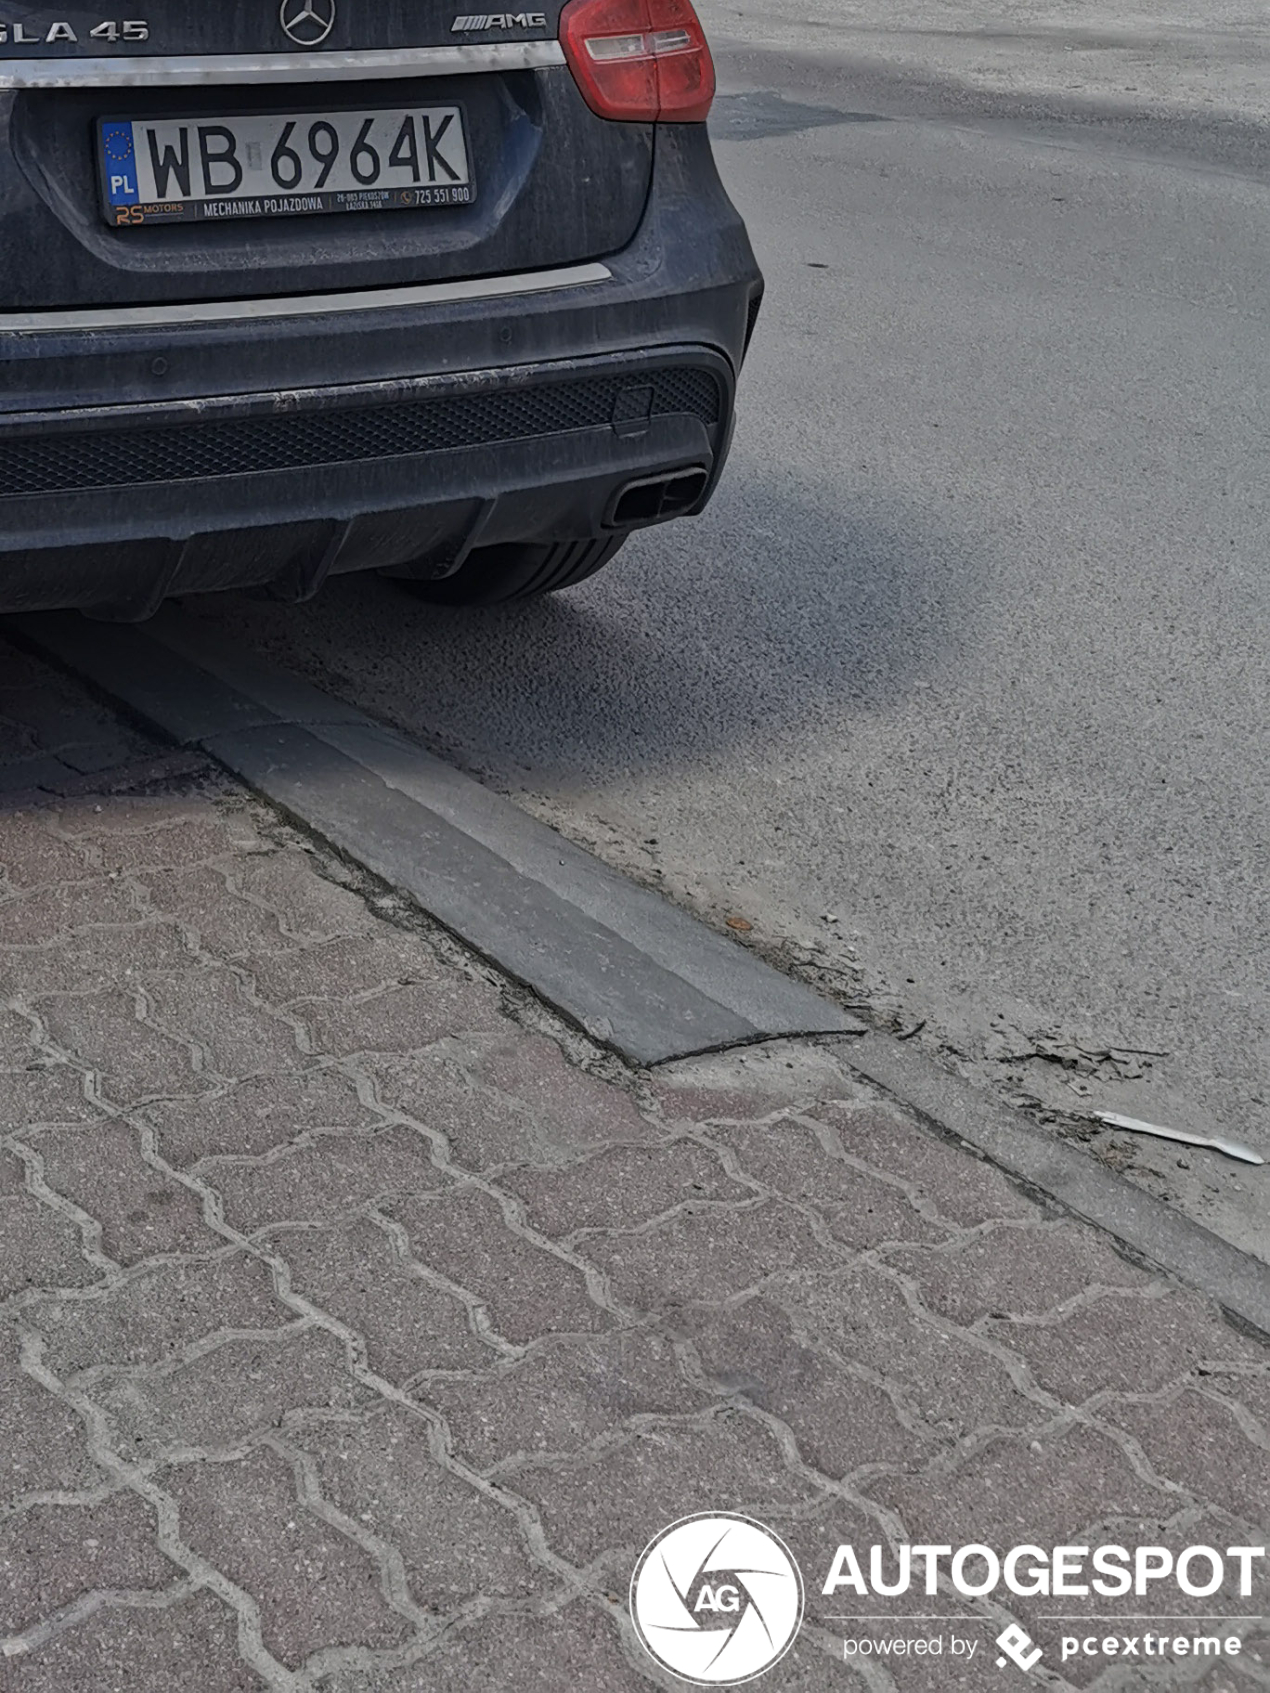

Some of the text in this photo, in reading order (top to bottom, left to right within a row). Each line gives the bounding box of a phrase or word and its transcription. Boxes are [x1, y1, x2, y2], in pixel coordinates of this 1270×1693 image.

[89, 20, 149, 43] 45
[483, 12, 547, 30] AMG
[146, 114, 462, 199] WB 6964K
[111, 175, 135, 196] PL
[415, 187, 470, 205] 725 551 900
[116, 202, 185, 225] RS MOTORS
[204, 196, 324, 217] MECHANIKA POJAZDOWA
